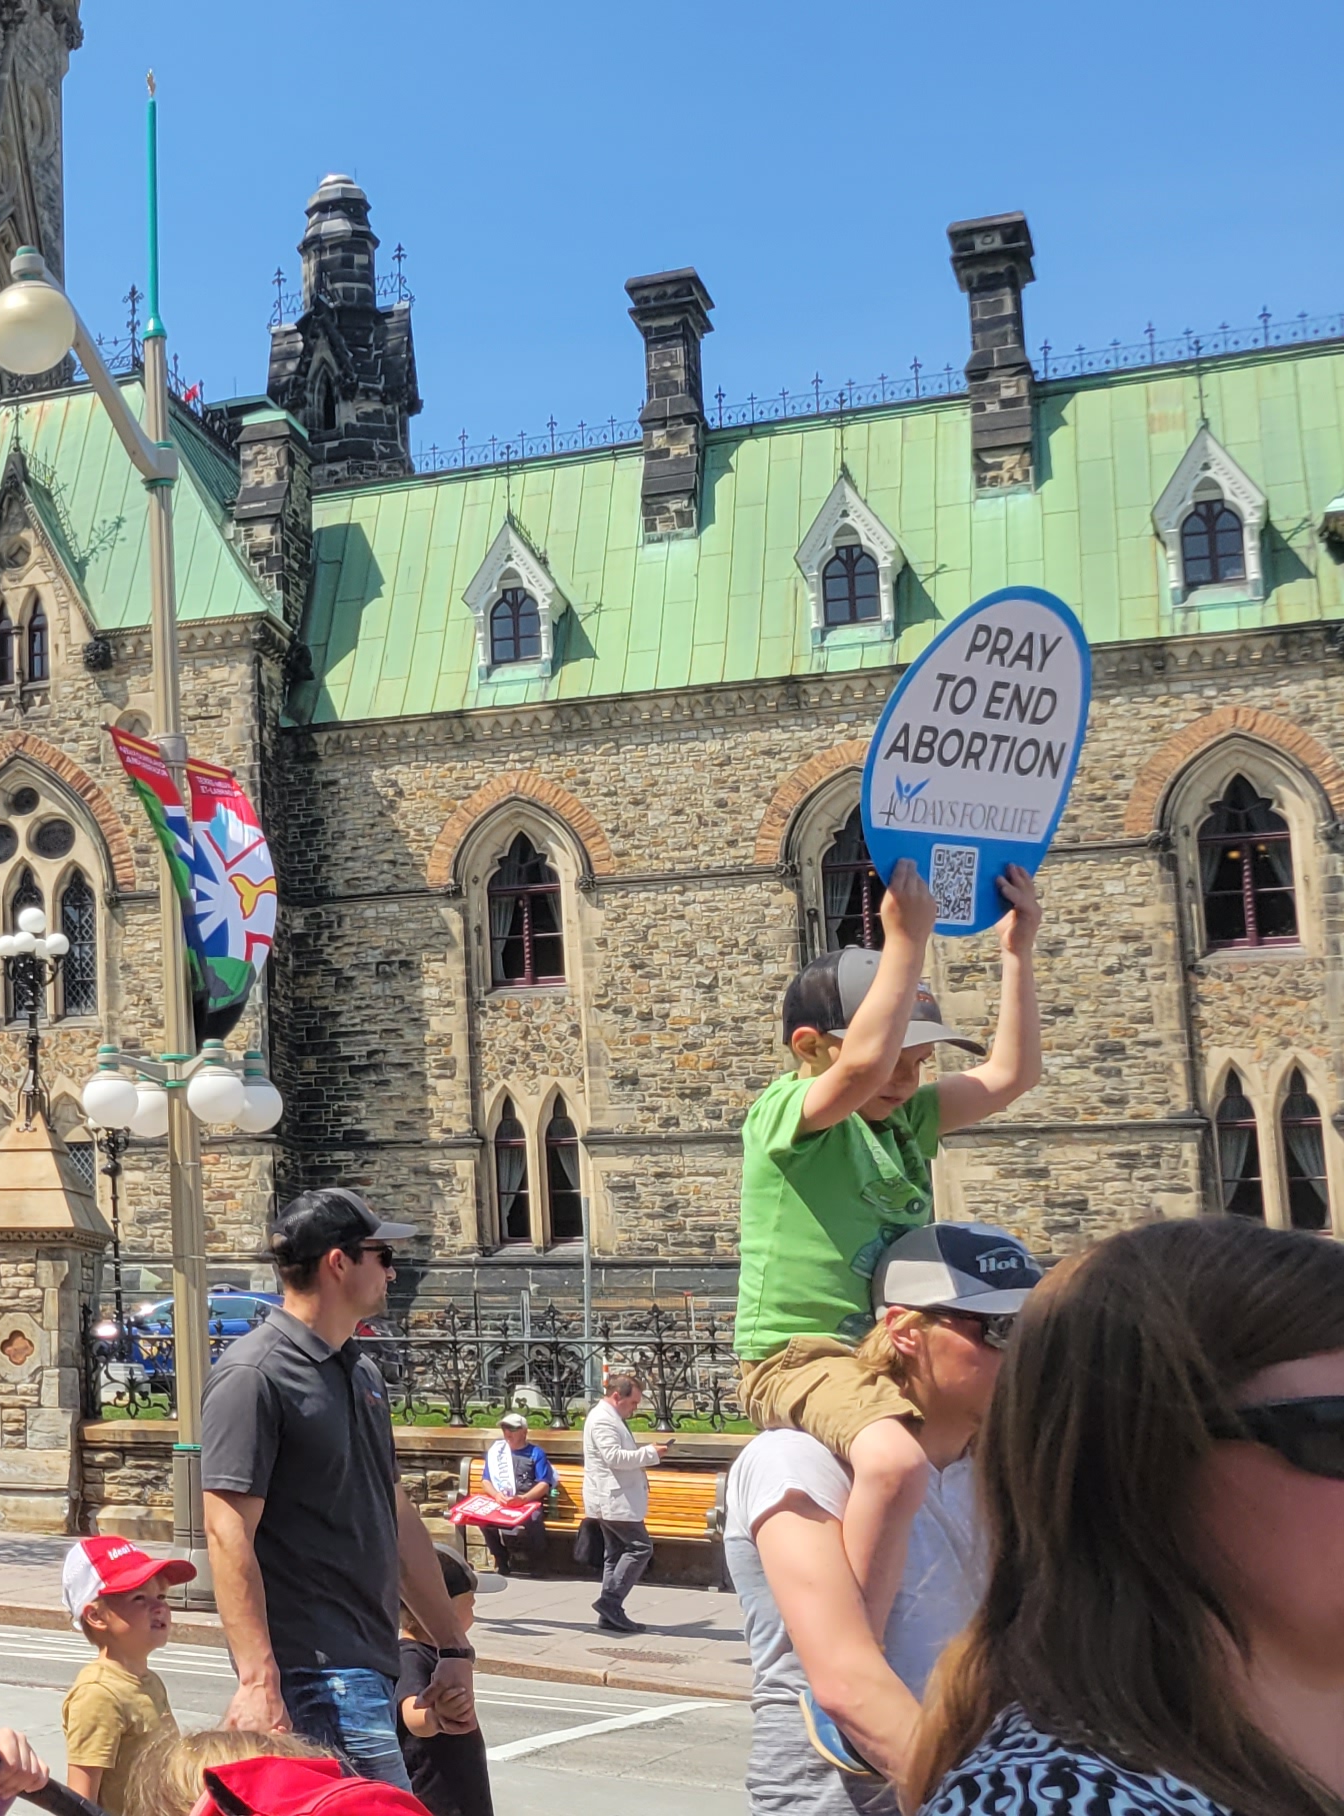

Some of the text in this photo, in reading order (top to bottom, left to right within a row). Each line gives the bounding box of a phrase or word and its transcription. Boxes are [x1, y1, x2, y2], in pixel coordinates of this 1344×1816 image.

[965, 623, 1063, 673] PRAY
[932, 672, 1058, 726] TO END
[882, 721, 1066, 780] ABORTION
